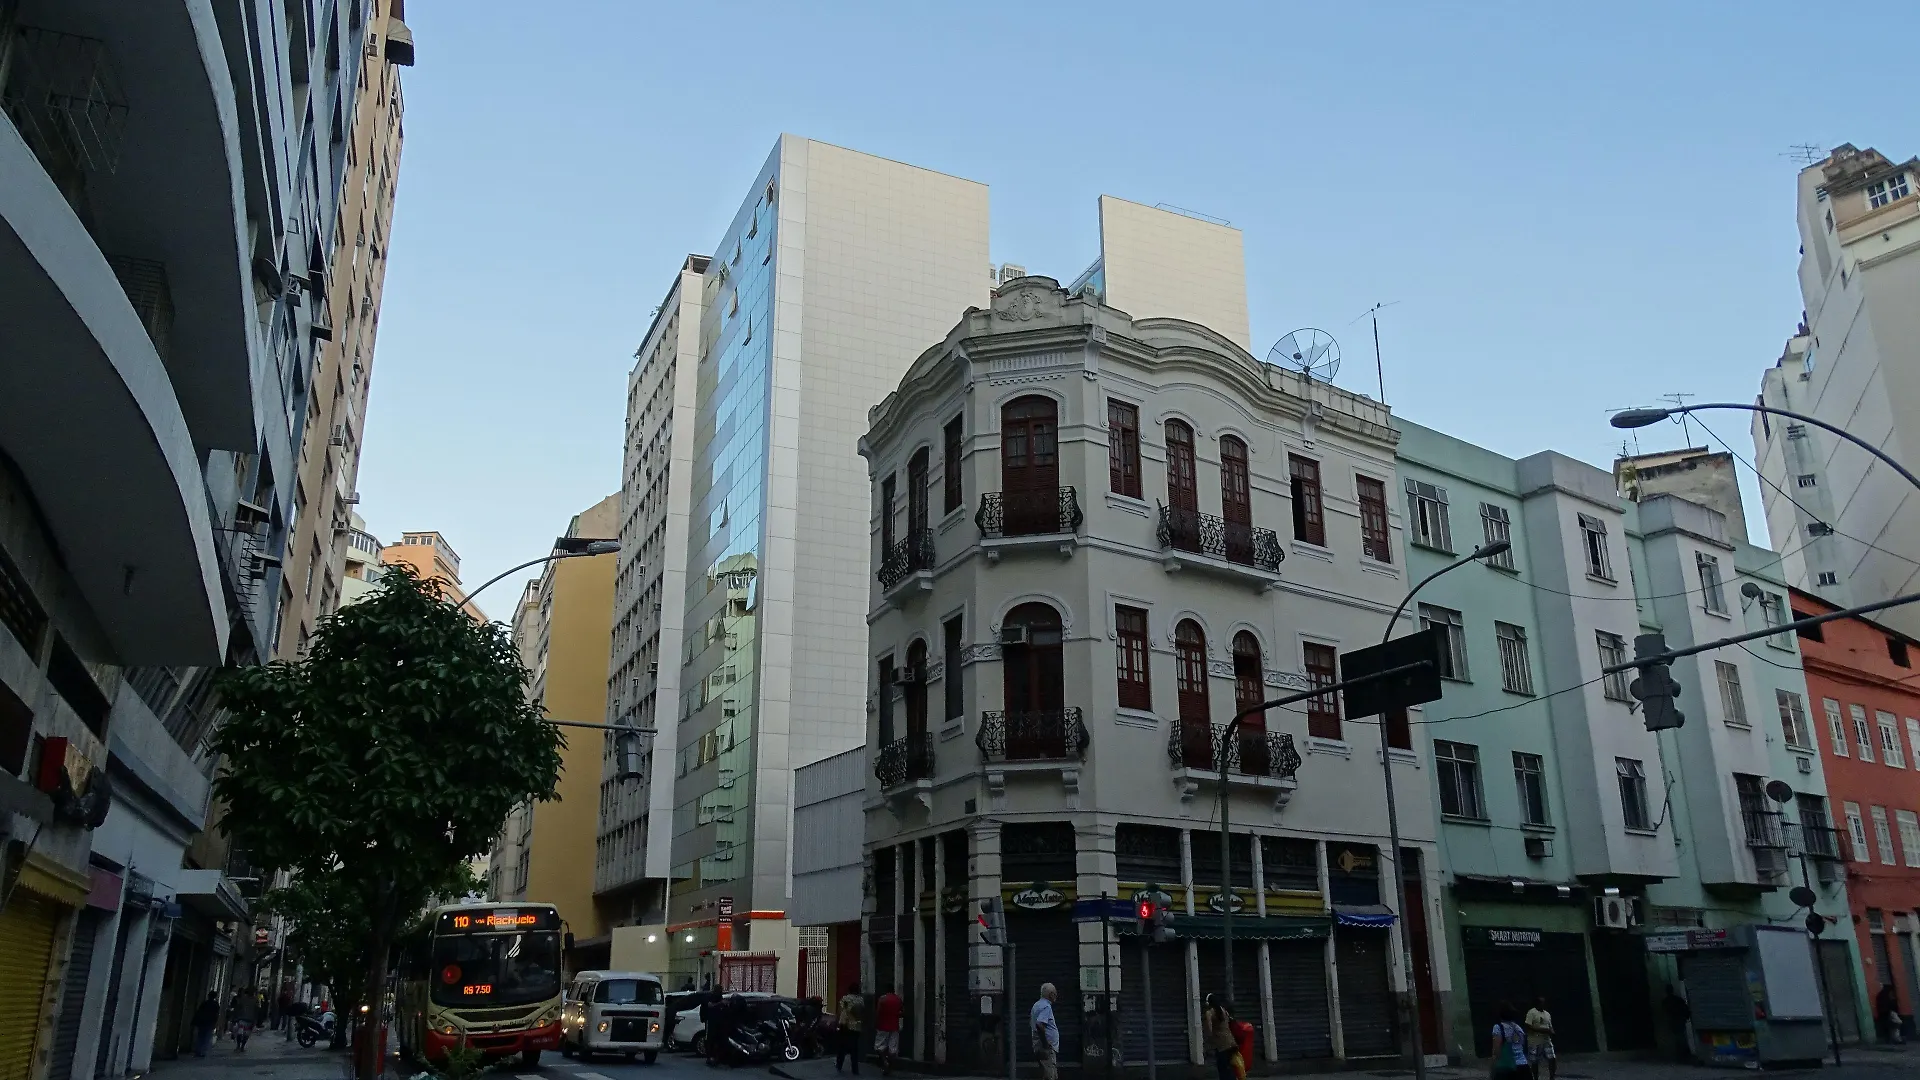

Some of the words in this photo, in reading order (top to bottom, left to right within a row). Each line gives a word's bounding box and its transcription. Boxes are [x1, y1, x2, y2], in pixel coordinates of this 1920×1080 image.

[454, 916, 469, 928] 110
[487, 915, 536, 925] Riachuelo
[1490, 929, 1510, 941] SMART
[1512, 931, 1541, 942] NUTRITION
